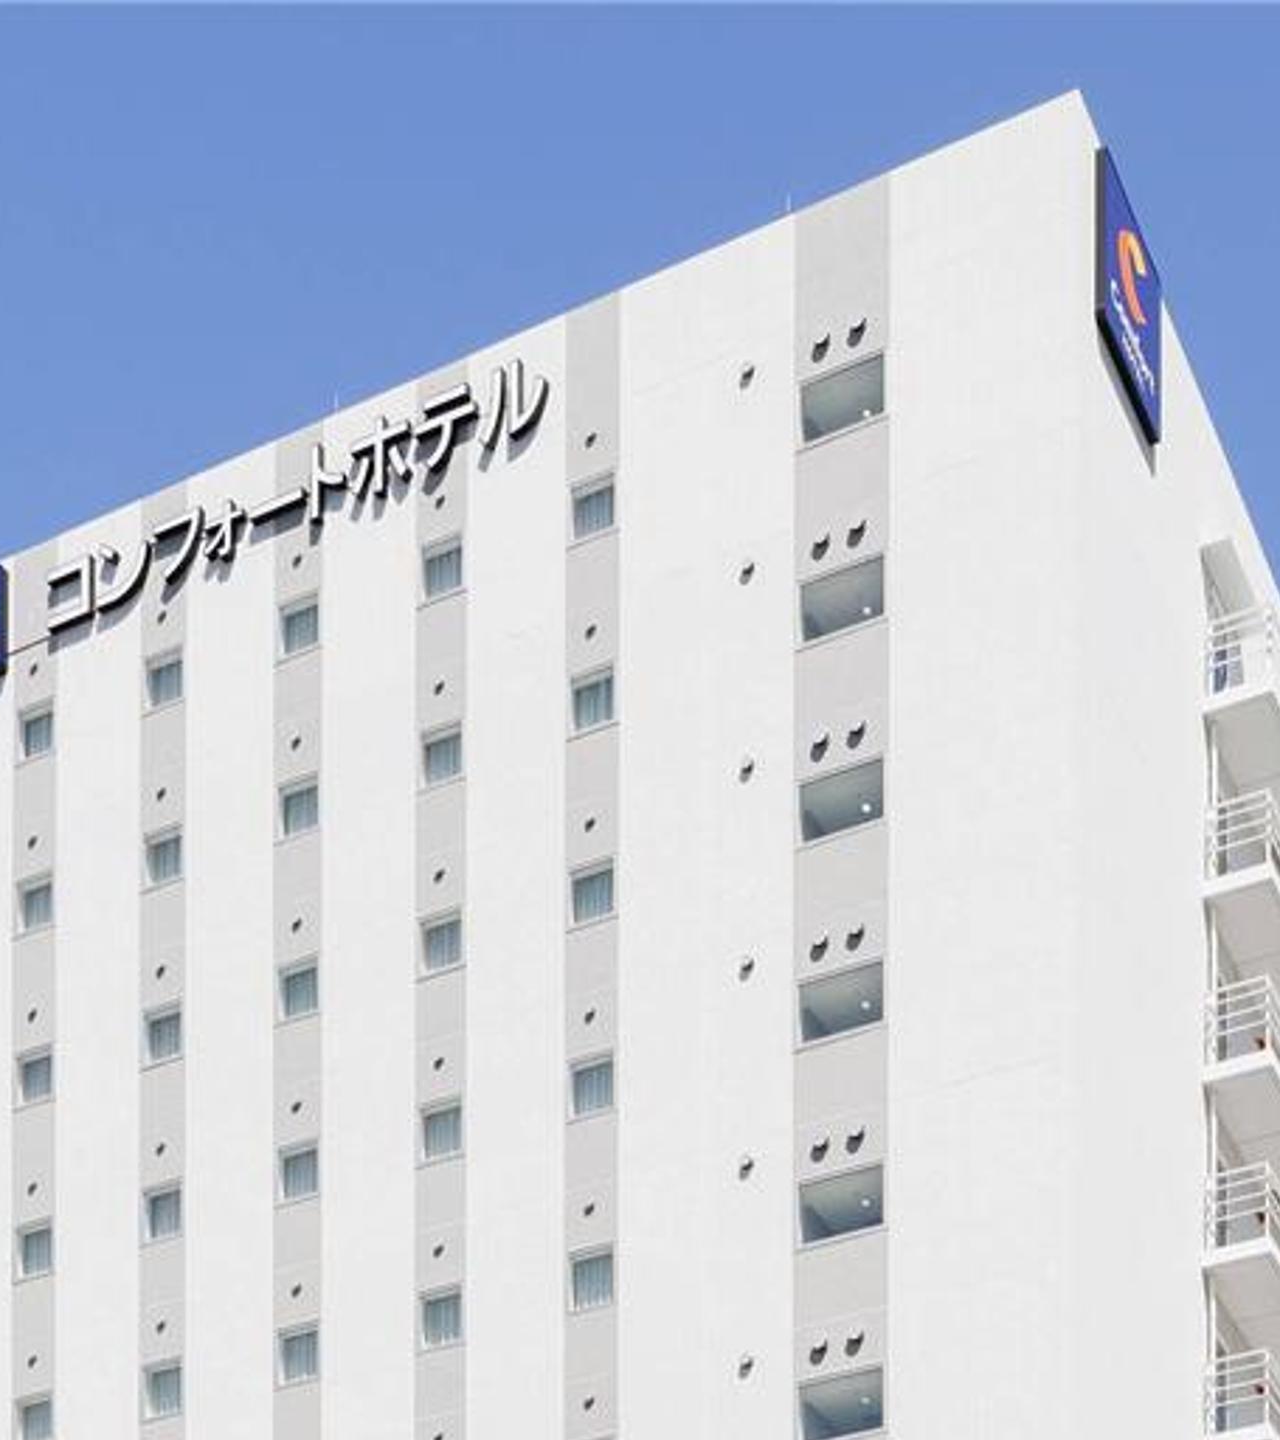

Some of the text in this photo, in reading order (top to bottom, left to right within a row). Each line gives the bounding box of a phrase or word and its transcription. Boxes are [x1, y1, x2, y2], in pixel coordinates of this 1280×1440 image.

[48, 358, 550, 636] コンフォートホテル
